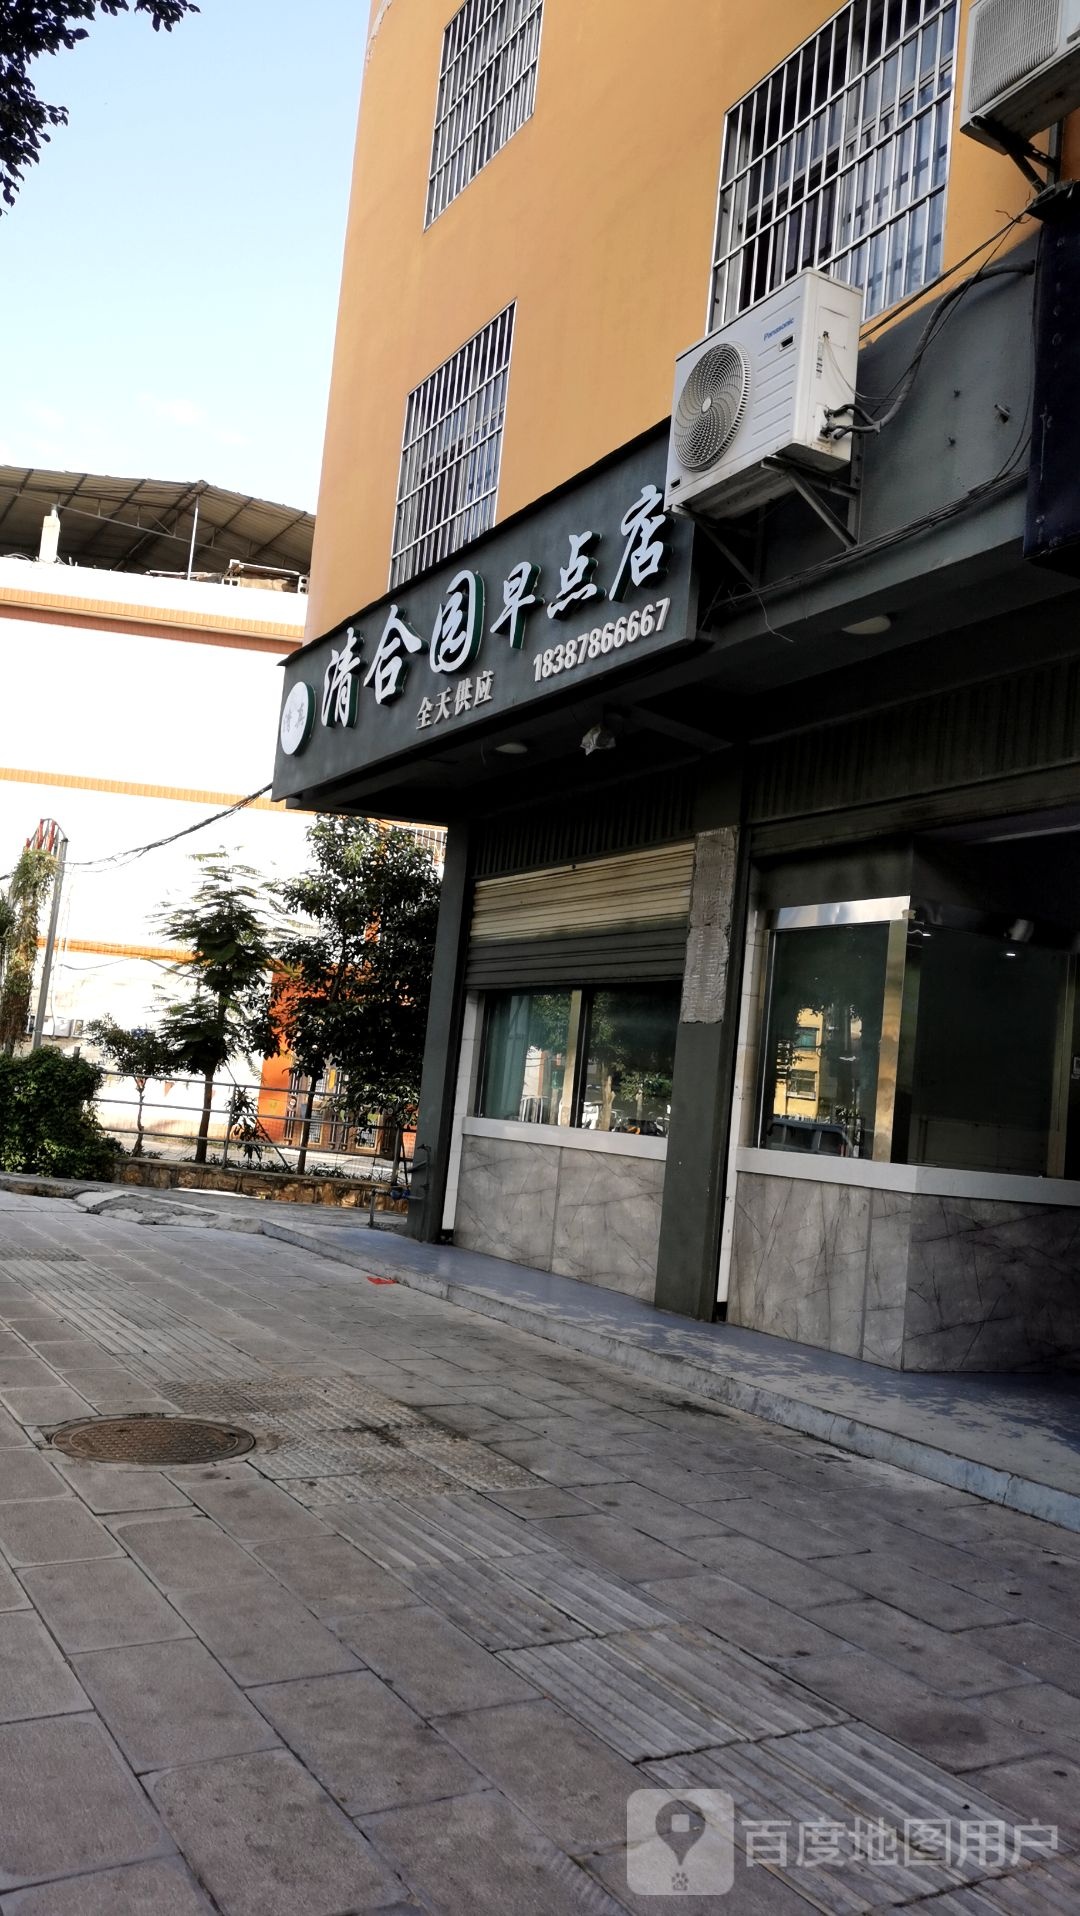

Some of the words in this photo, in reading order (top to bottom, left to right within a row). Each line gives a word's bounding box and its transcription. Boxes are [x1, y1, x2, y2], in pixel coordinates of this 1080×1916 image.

[763, 317, 795, 341] Panasonic
[533, 597, 671, 682] 18387866667
[416, 670, 494, 730] 全天供应
